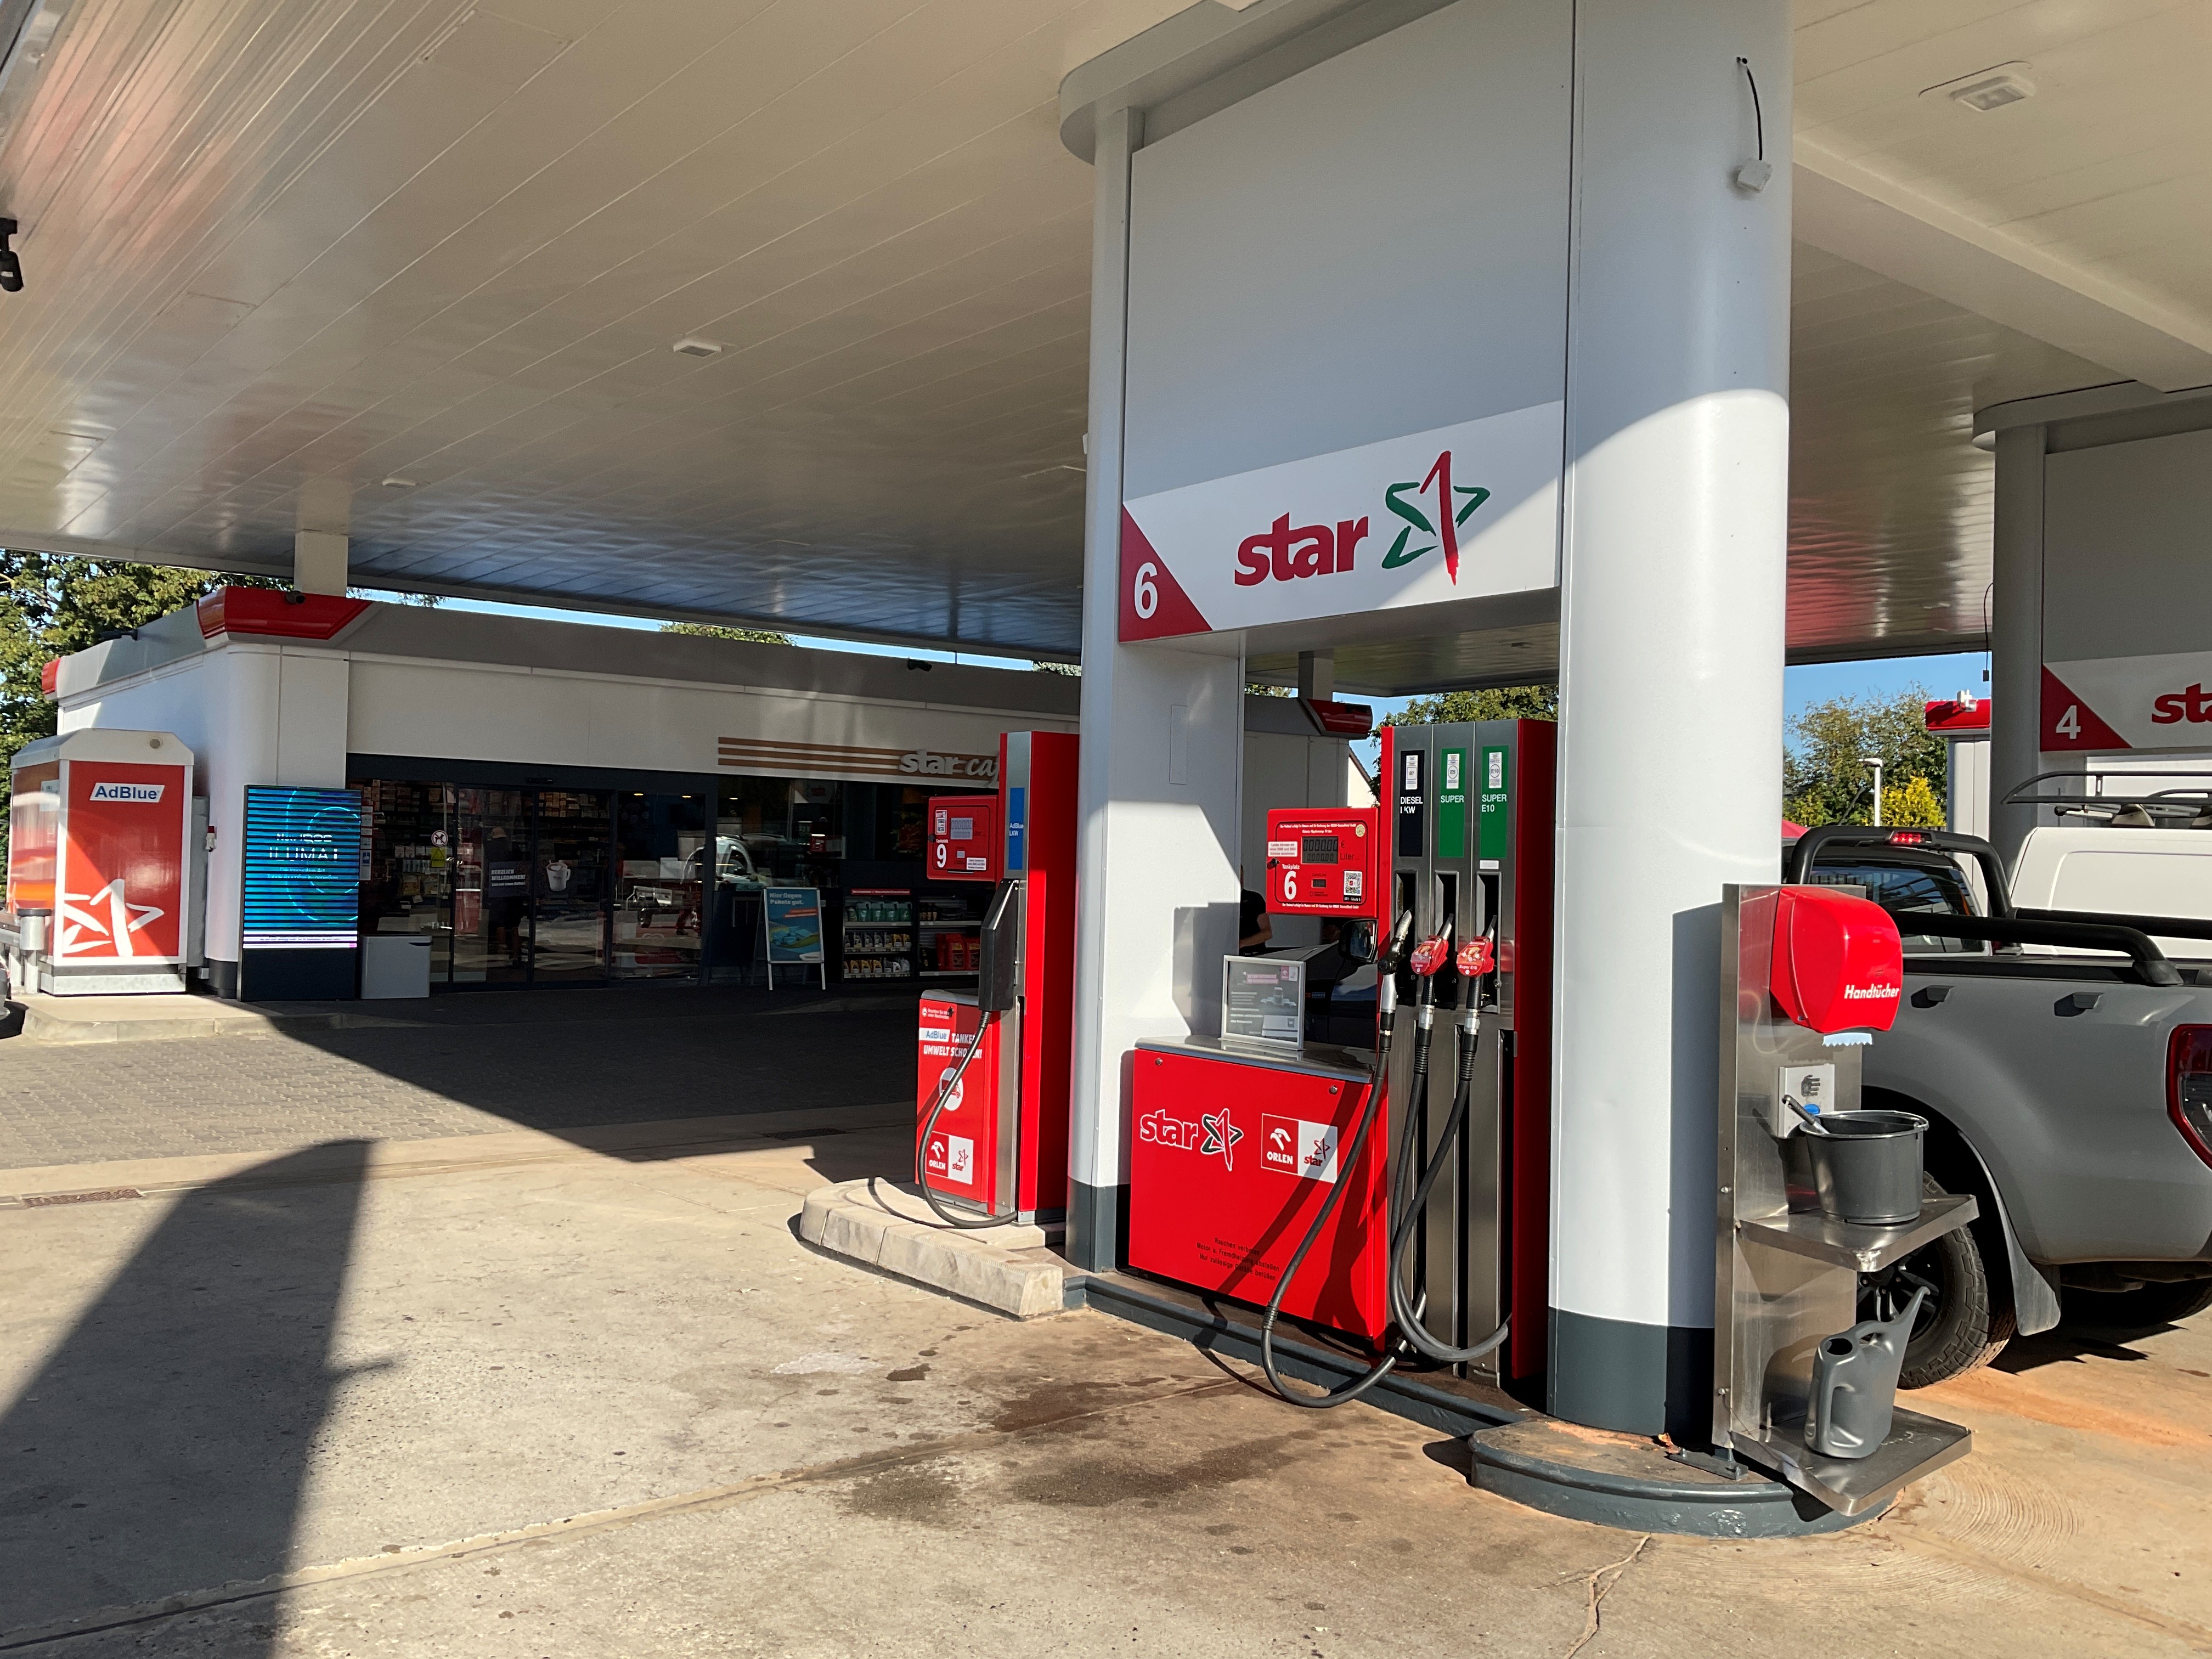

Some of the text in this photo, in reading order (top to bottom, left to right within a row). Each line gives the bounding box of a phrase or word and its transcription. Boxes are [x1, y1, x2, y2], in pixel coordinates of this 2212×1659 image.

[1234, 512, 1368, 586] star
[1134, 562, 1158, 619] 6
[2152, 682, 2212, 724] st
[2056, 705, 2081, 739] 4
[899, 749, 959, 775] star
[94, 785, 157, 800] AdBlue
[1441, 795, 1464, 803] SUPER
[1482, 794, 1507, 803] SUPER
[1481, 804, 1495, 812] E10
[937, 844, 947, 868] 9
[1284, 871, 1297, 900] 6
[1844, 983, 1899, 999] Handtücher
[926, 1030, 947, 1040] AdBlue
[923, 1045, 983, 1059] UMWELT SCHON!
[1140, 1109, 1199, 1150] star
[929, 1159, 946, 1170] ORLEN
[1266, 1151, 1293, 1165] ORLEN
[1304, 1155, 1323, 1167] star
[952, 1162, 964, 1171] star
[1197, 1242, 1211, 1251] Motor
[1214, 1237, 1235, 1249] Rauchen
